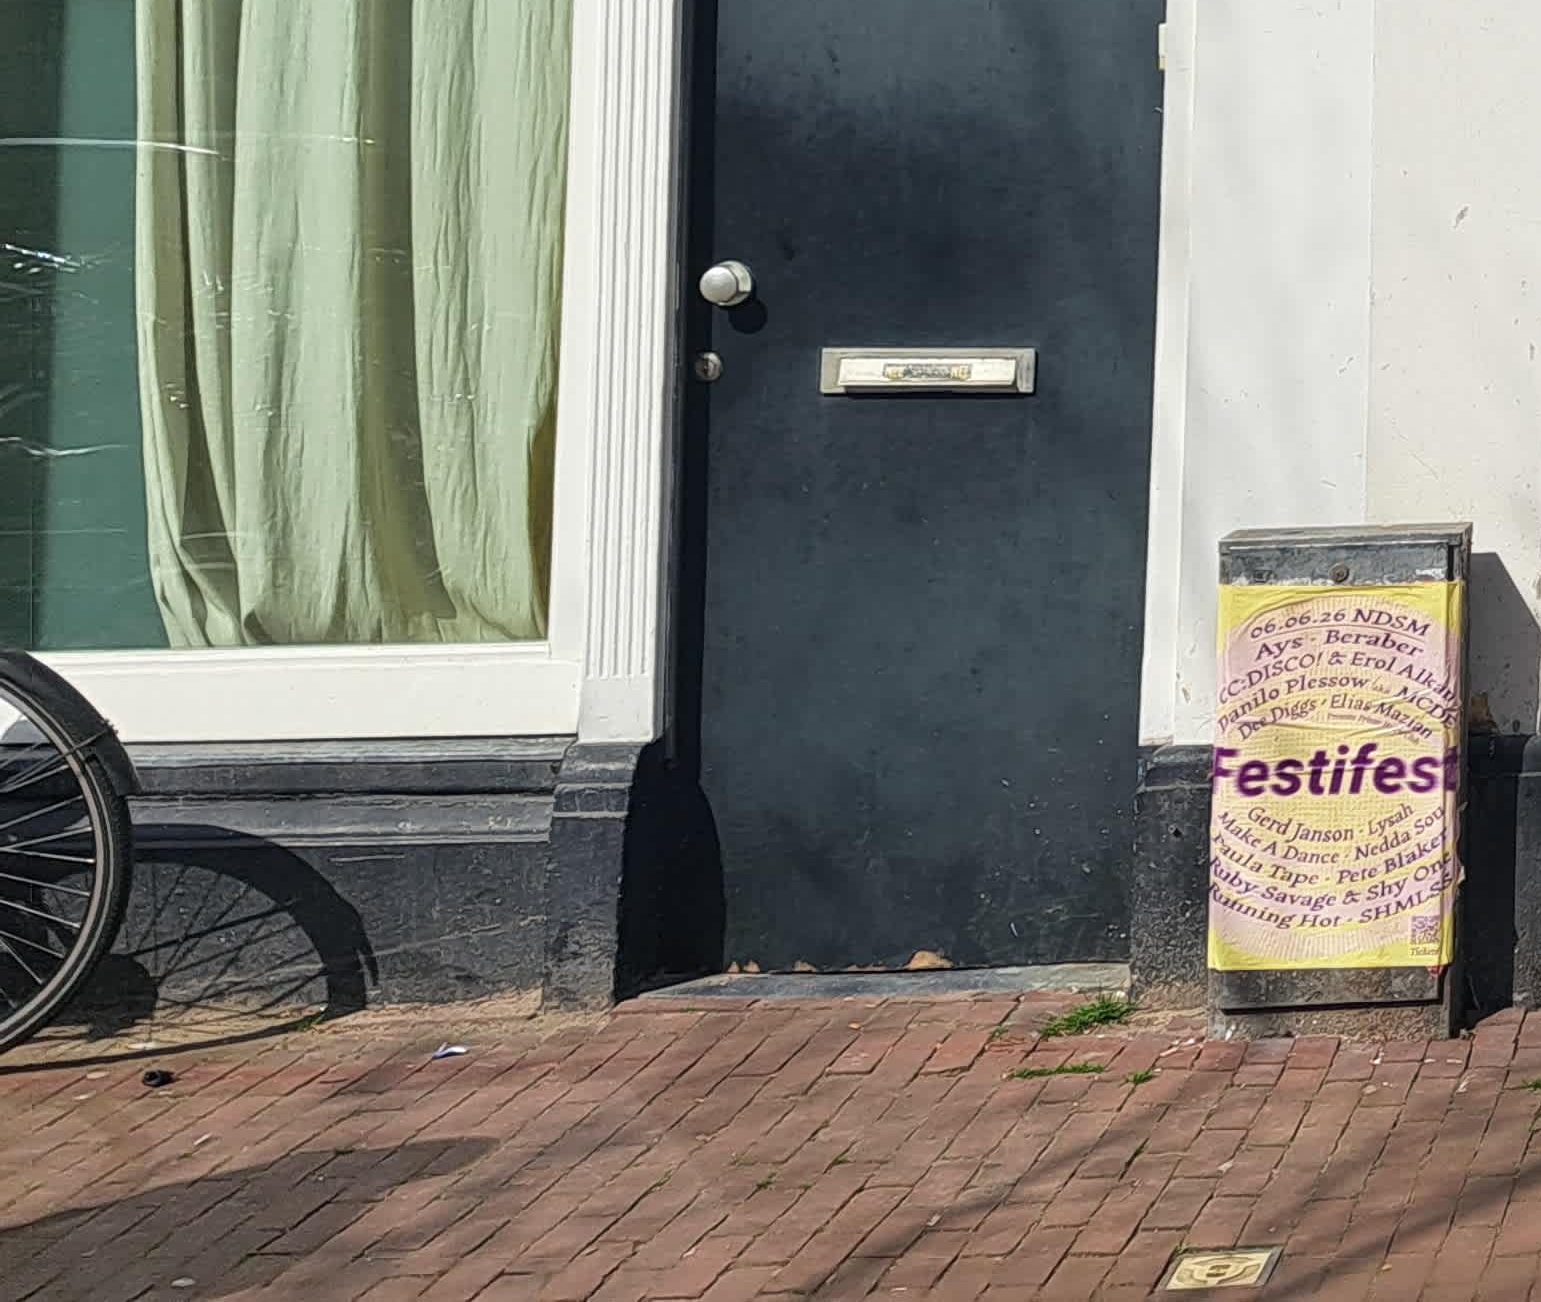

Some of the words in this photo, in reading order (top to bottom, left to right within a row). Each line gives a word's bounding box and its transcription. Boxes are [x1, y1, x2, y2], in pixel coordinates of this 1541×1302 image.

[1250, 608, 1346, 639] 06.06.26
[1352, 608, 1431, 637] NDSM
[1255, 636, 1304, 661] Ays
[1323, 629, 1424, 657] Beraber
[1285, 674, 1372, 696] Plessow
[1328, 650, 1347, 666] &
[1350, 651, 1398, 672] Erol
[1397, 663, 1457, 703] Alkan
[1238, 716, 1267, 741] Dee
[1270, 698, 1318, 724] Diggs
[1330, 693, 1372, 712] Elias
[1375, 702, 1433, 739] Mazian
[1213, 742, 1459, 797] Festifest
[1218, 811, 1262, 848] Make
[1262, 841, 1277, 856] A
[1282, 845, 1340, 865] Dance
[1354, 830, 1412, 860] Nedda
[1248, 806, 1293, 836] Gerd
[1284, 823, 1354, 843] Janson
[1367, 803, 1414, 836] Lysah
[1209, 856, 1260, 895] Ruby
[1260, 885, 1337, 912] Savage
[1342, 889, 1362, 906] &
[1366, 877, 1409, 901] Shy
[1413, 852, 1452, 881] One
[1212, 833, 1263, 874] Paula
[1268, 863, 1320, 888] Tape
[1335, 867, 1378, 885] Pete
[1383, 828, 1448, 875] Blaker
[1208, 882, 1298, 929] Running
[1297, 913, 1342, 928] Hot
